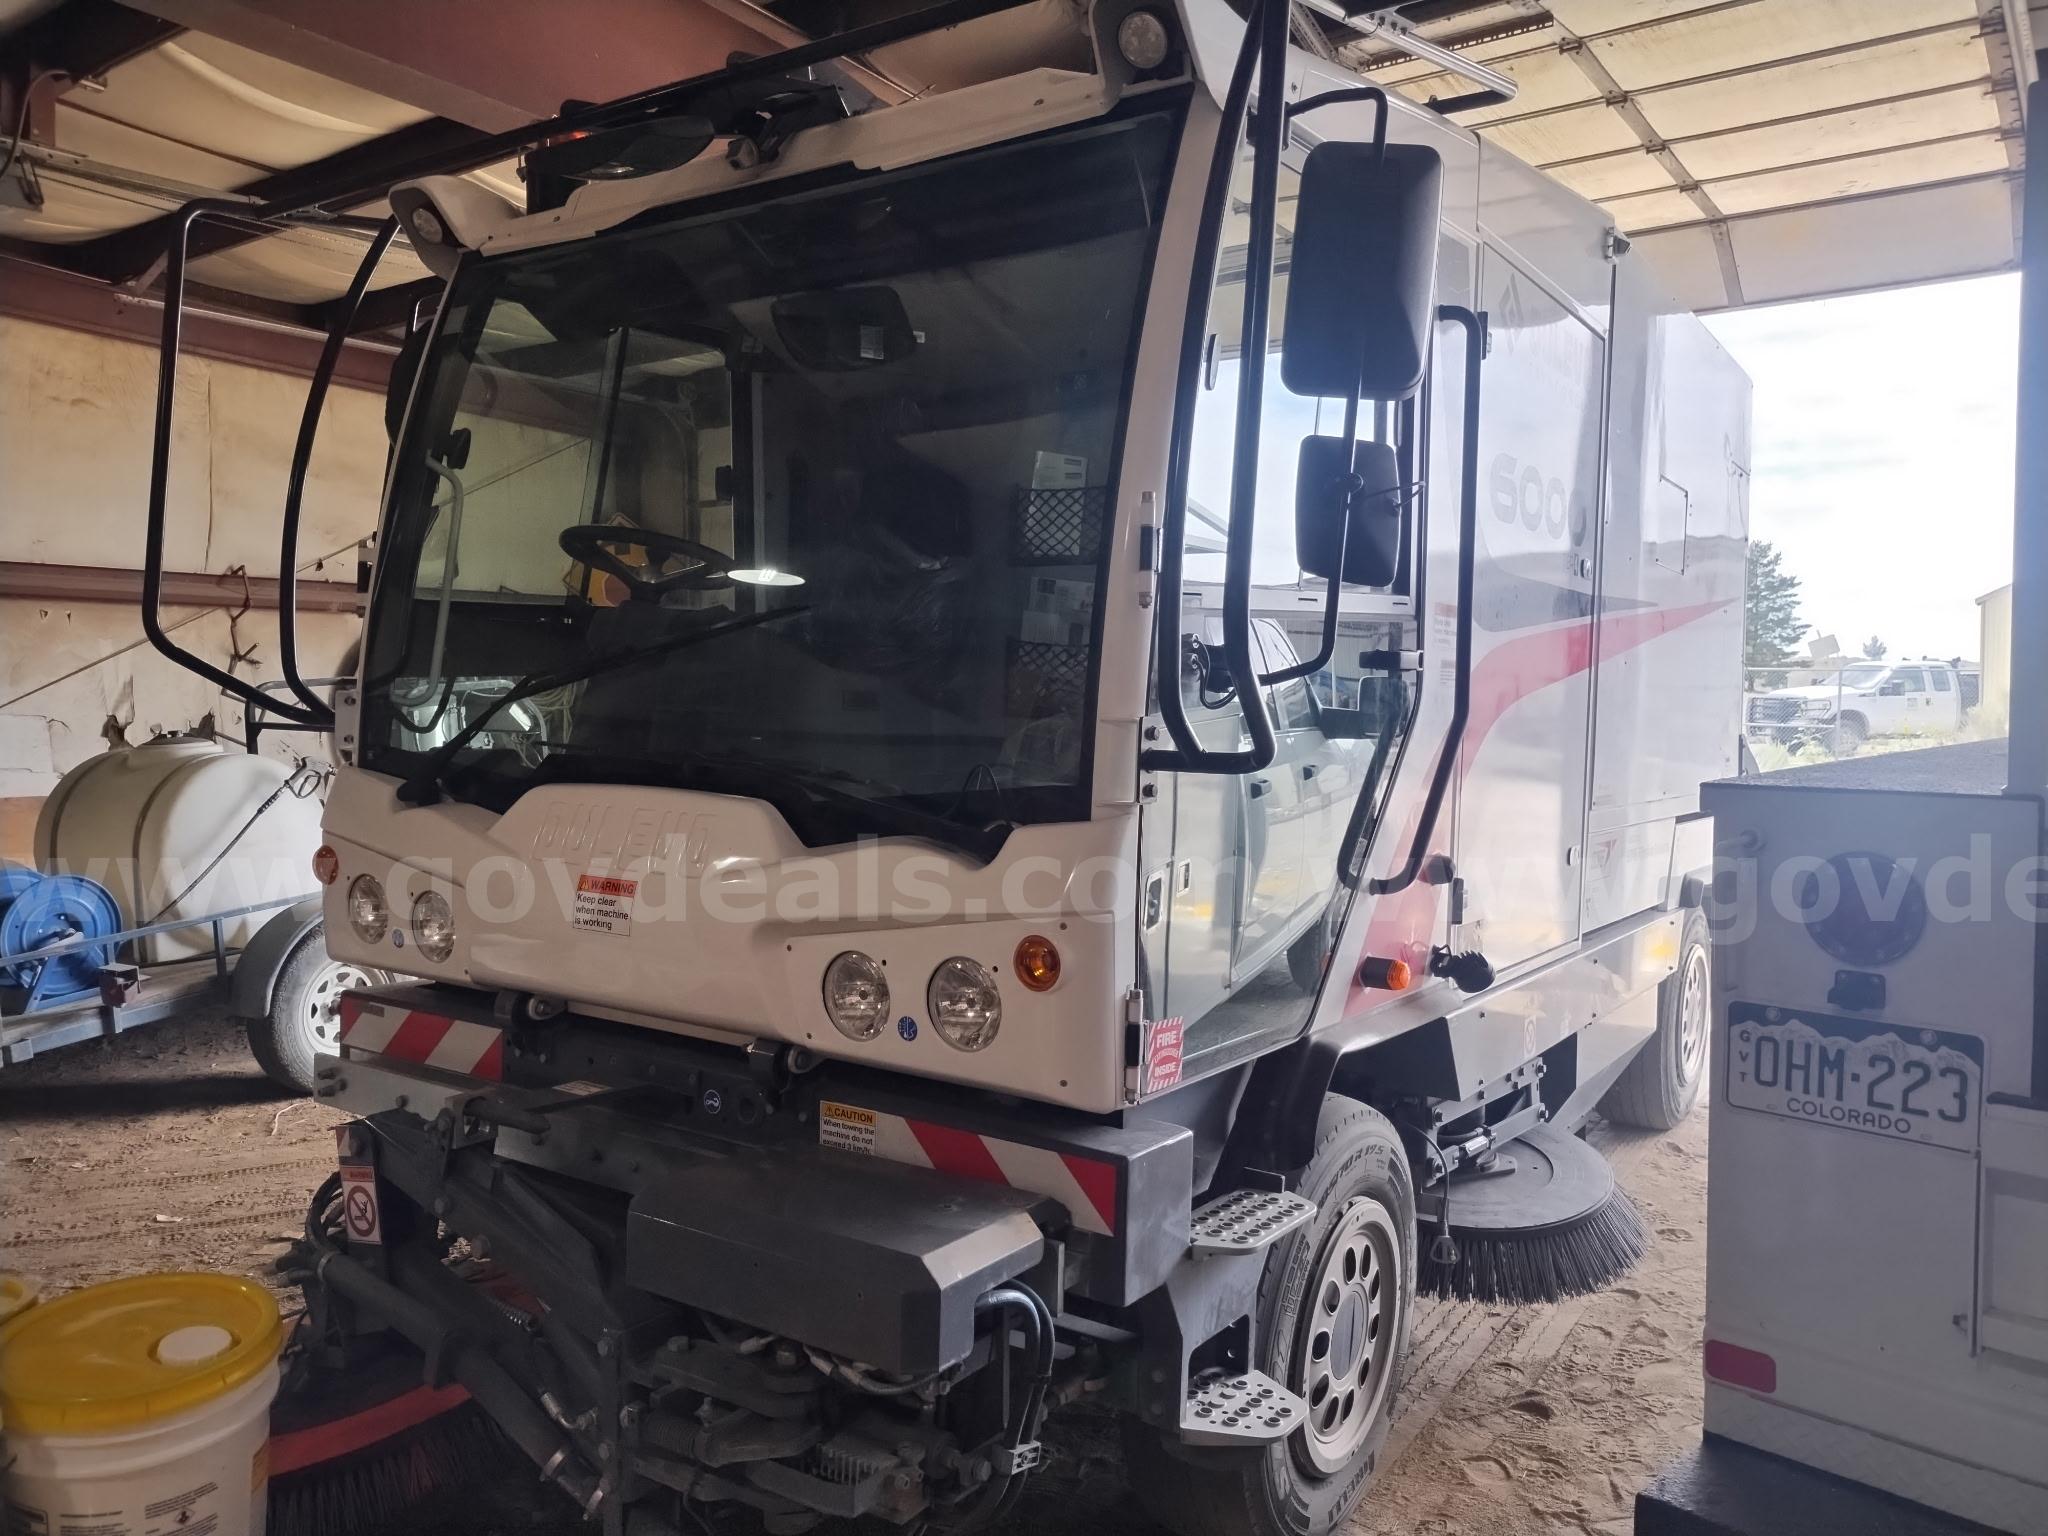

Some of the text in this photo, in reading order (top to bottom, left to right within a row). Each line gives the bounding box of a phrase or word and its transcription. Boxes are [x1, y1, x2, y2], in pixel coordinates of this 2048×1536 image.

[591, 880, 634, 894] WARNING
[577, 893, 617, 907] Keep clear
[575, 905, 629, 920] when machine
[574, 916, 612, 931] is working
[1157, 1031, 1177, 1048] FIRE
[1154, 1061, 1177, 1077] INSIDE
[834, 1107, 873, 1123] CAUTION
[1786, 1098, 1912, 1134] COLORADO
[823, 1118, 875, 1136] When towing the
[823, 1129, 873, 1146] machine do not
[823, 1139, 845, 1149] exceed
